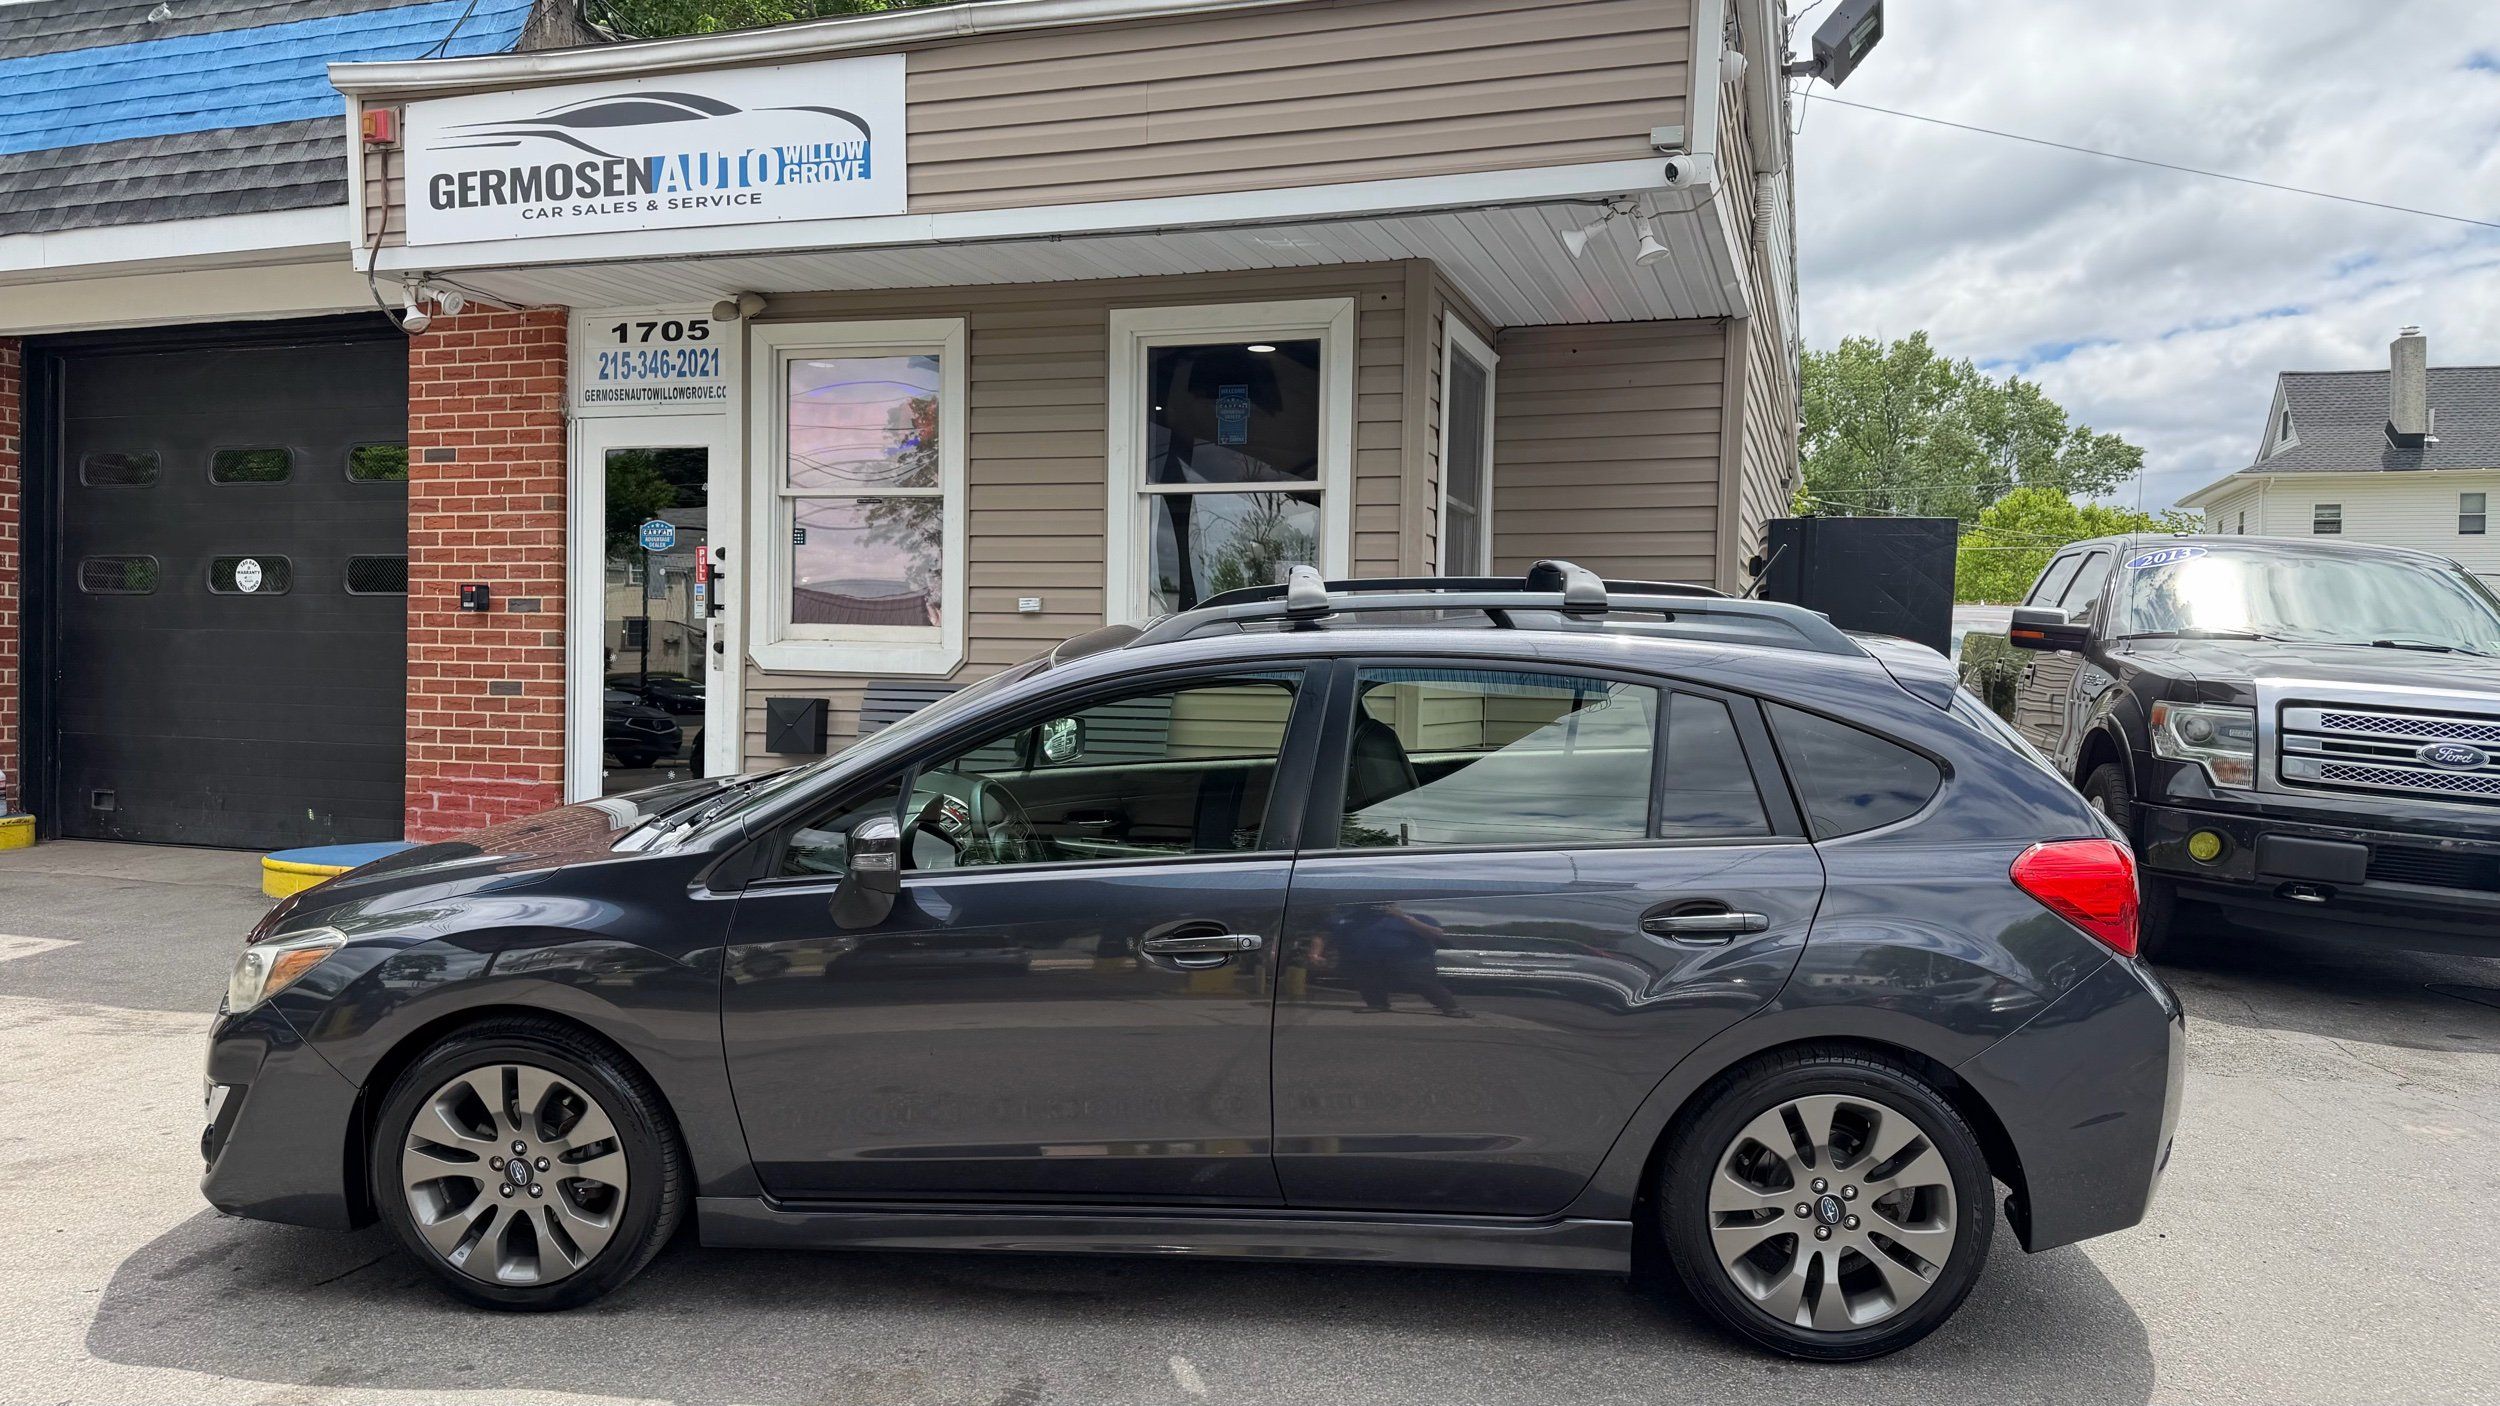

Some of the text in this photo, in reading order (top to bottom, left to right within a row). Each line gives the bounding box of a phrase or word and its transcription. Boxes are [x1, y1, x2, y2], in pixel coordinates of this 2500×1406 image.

[783, 141, 865, 164] WILLOW
[429, 148, 780, 211] GERMOSEN AUTO
[783, 160, 865, 185] GROVE
[522, 192, 762, 220] CAR SALES & SERVICE
[611, 320, 710, 344] 1705
[598, 348, 719, 380] 215-346-2021
[2140, 549, 2192, 566] 2013
[2435, 747, 2474, 763] Ford
